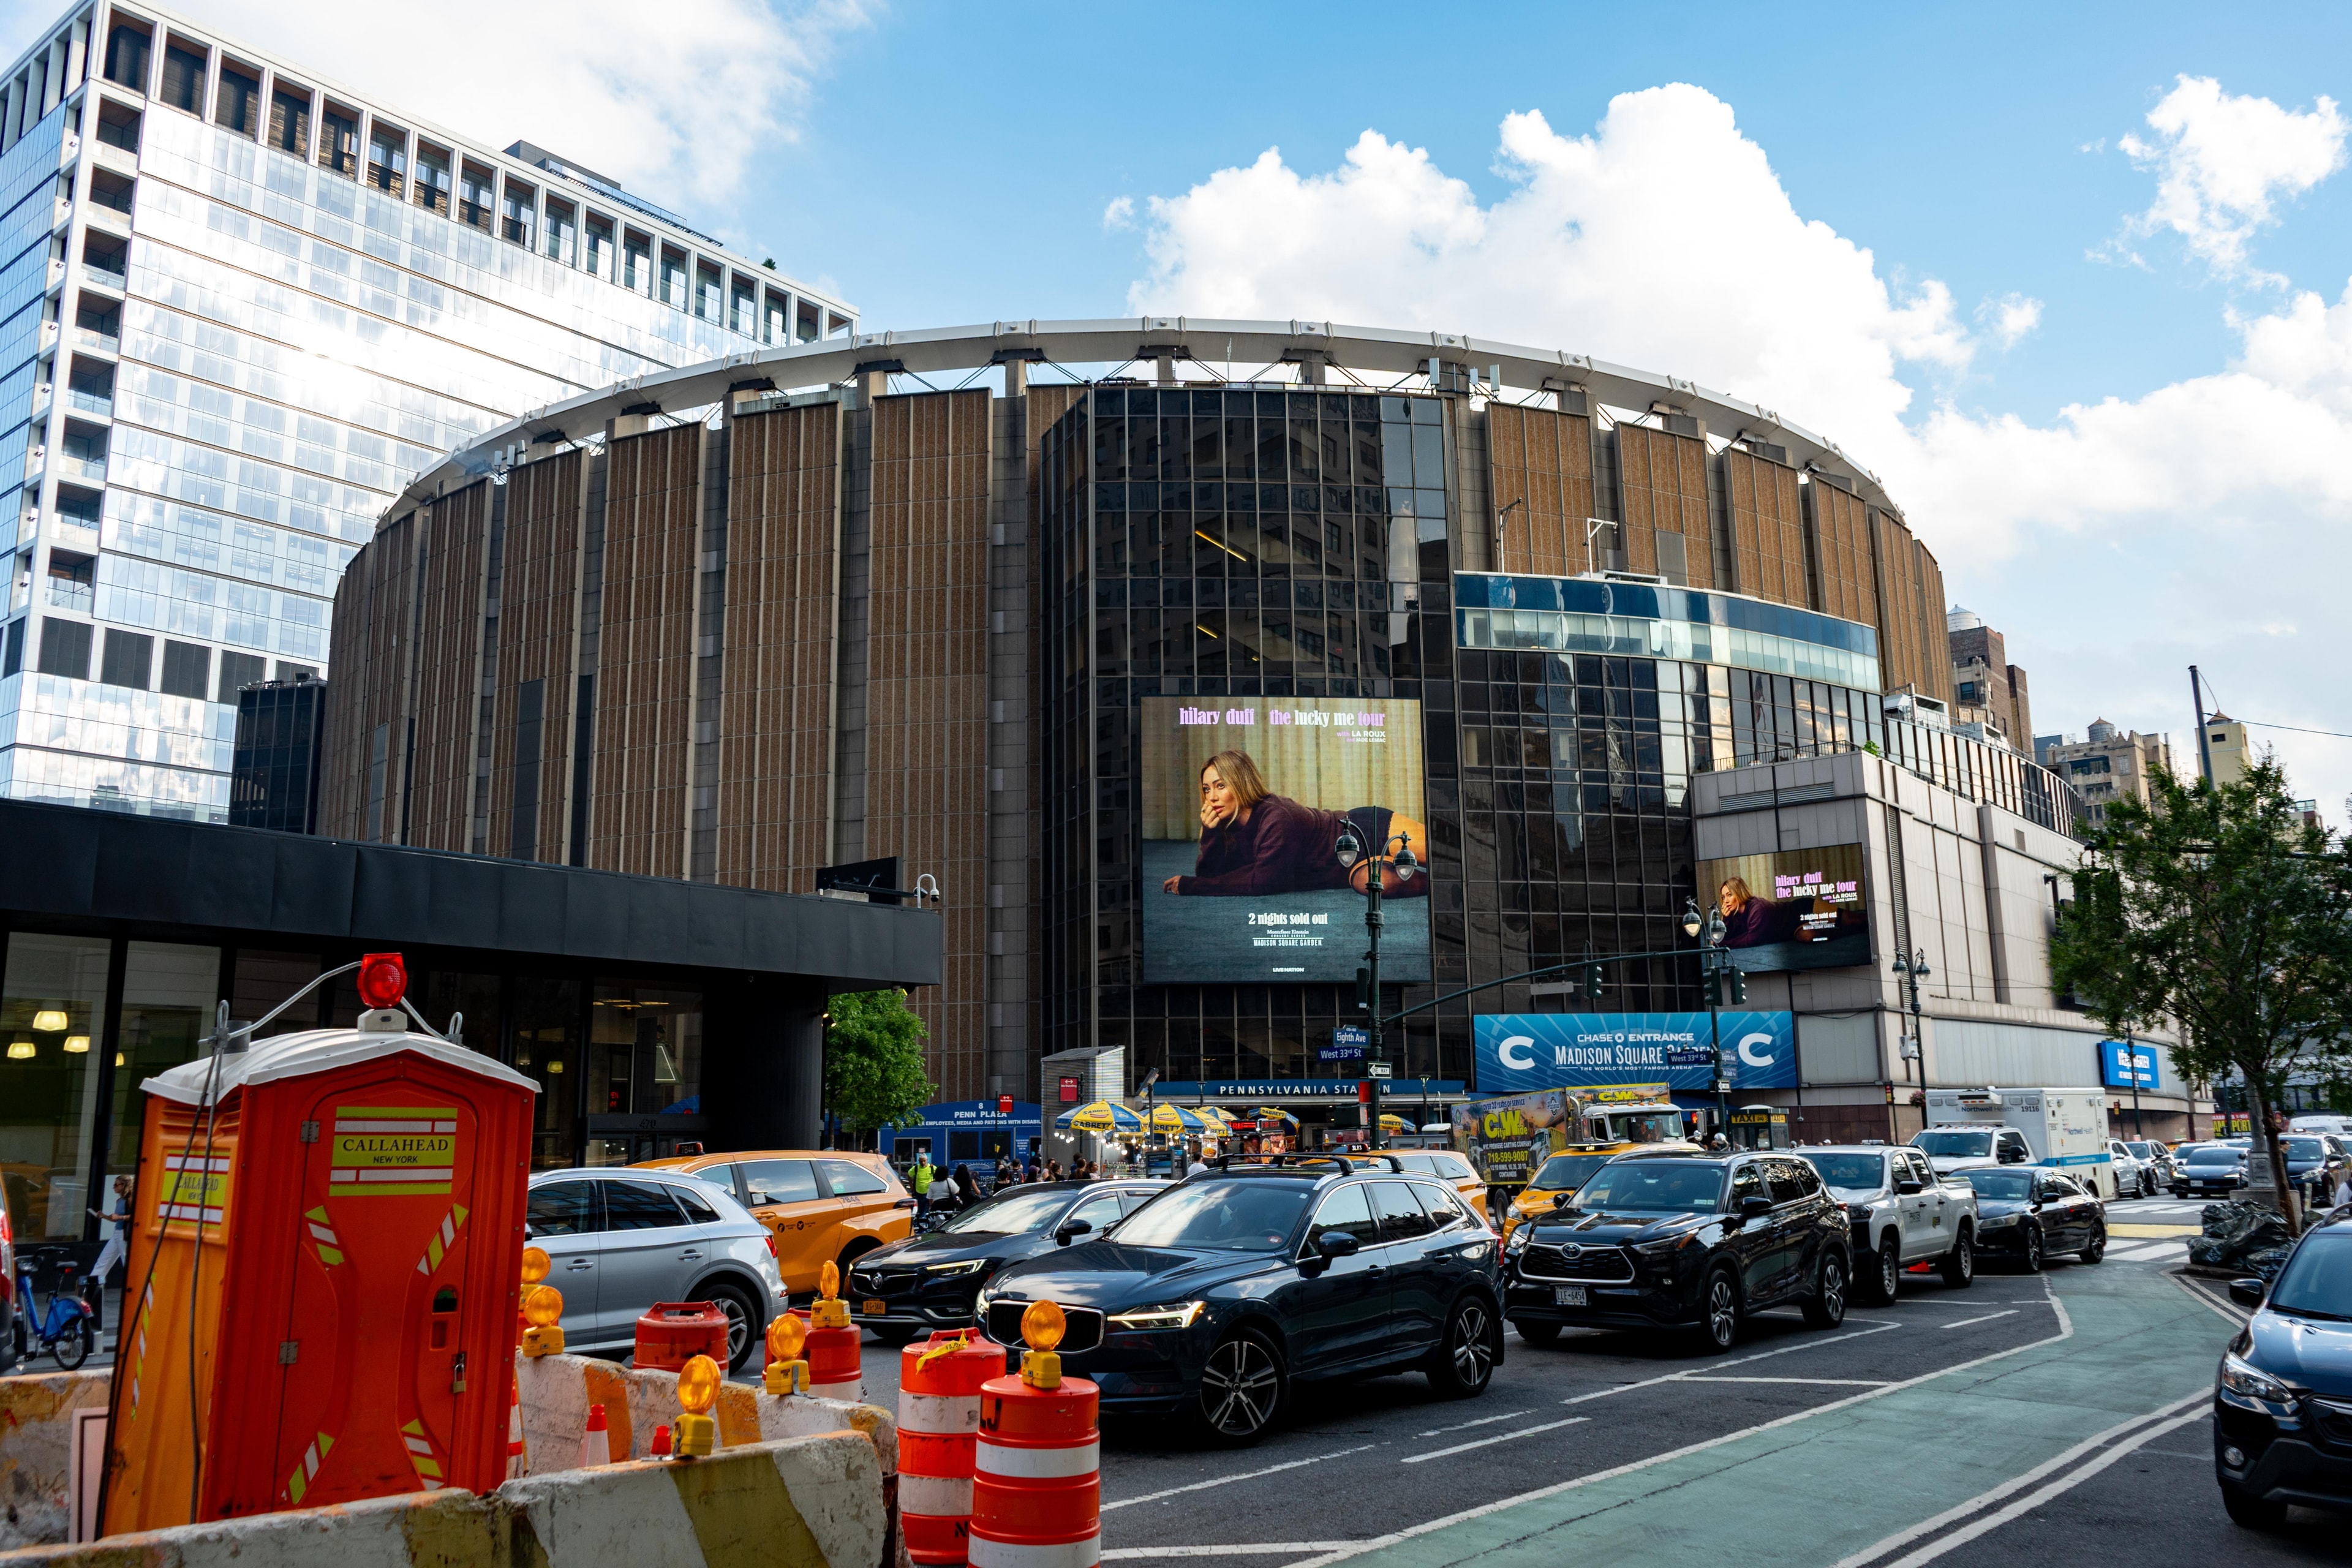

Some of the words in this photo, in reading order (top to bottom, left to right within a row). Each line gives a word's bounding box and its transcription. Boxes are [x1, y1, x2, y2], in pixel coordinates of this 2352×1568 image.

[1179, 707, 1220, 725] hilary
[1226, 709, 1255, 725] duff
[1269, 710, 1291, 725] the
[1294, 710, 1330, 727] lucky
[1333, 712, 1355, 726] me
[1358, 711, 1385, 726] tour
[1775, 875, 1801, 887] hilary
[1803, 872, 1822, 884] duff
[1776, 887, 1792, 899] the
[1793, 884, 1818, 897] lucky
[1819, 883, 1835, 894] me
[1836, 881, 1856, 892] tour
[1248, 913, 1256, 925] 2
[1257, 913, 1287, 926] nights
[1289, 913, 1310, 925] sold
[1311, 913, 1328, 925] out
[1336, 1032, 1354, 1043] Eighth
[1355, 1033, 1366, 1042] Ave
[1577, 1034, 1613, 1042] CHASE
[1628, 1033, 1694, 1042] ENTRANCE
[1321, 1050, 1338, 1059] West
[1340, 1049, 1352, 1058] 33rd
[1354, 1049, 1362, 1057] St
[1555, 1046, 1612, 1065] MADISON
[1616, 1044, 1663, 1066] SQUARE
[1220, 1085, 1328, 1095] PENNSYLVANIA
[1334, 1085, 1390, 1094] STAN
[1512, 1098, 1525, 1107] SERVICE
[639, 1119, 656, 1128] 470
[342, 1139, 448, 1152] CALLAHEAD
[1487, 1150, 1529, 1163] 718-599-9087
[178, 1176, 219, 1191] CALLAEAD
[1557, 1291, 1567, 1300] LLE
